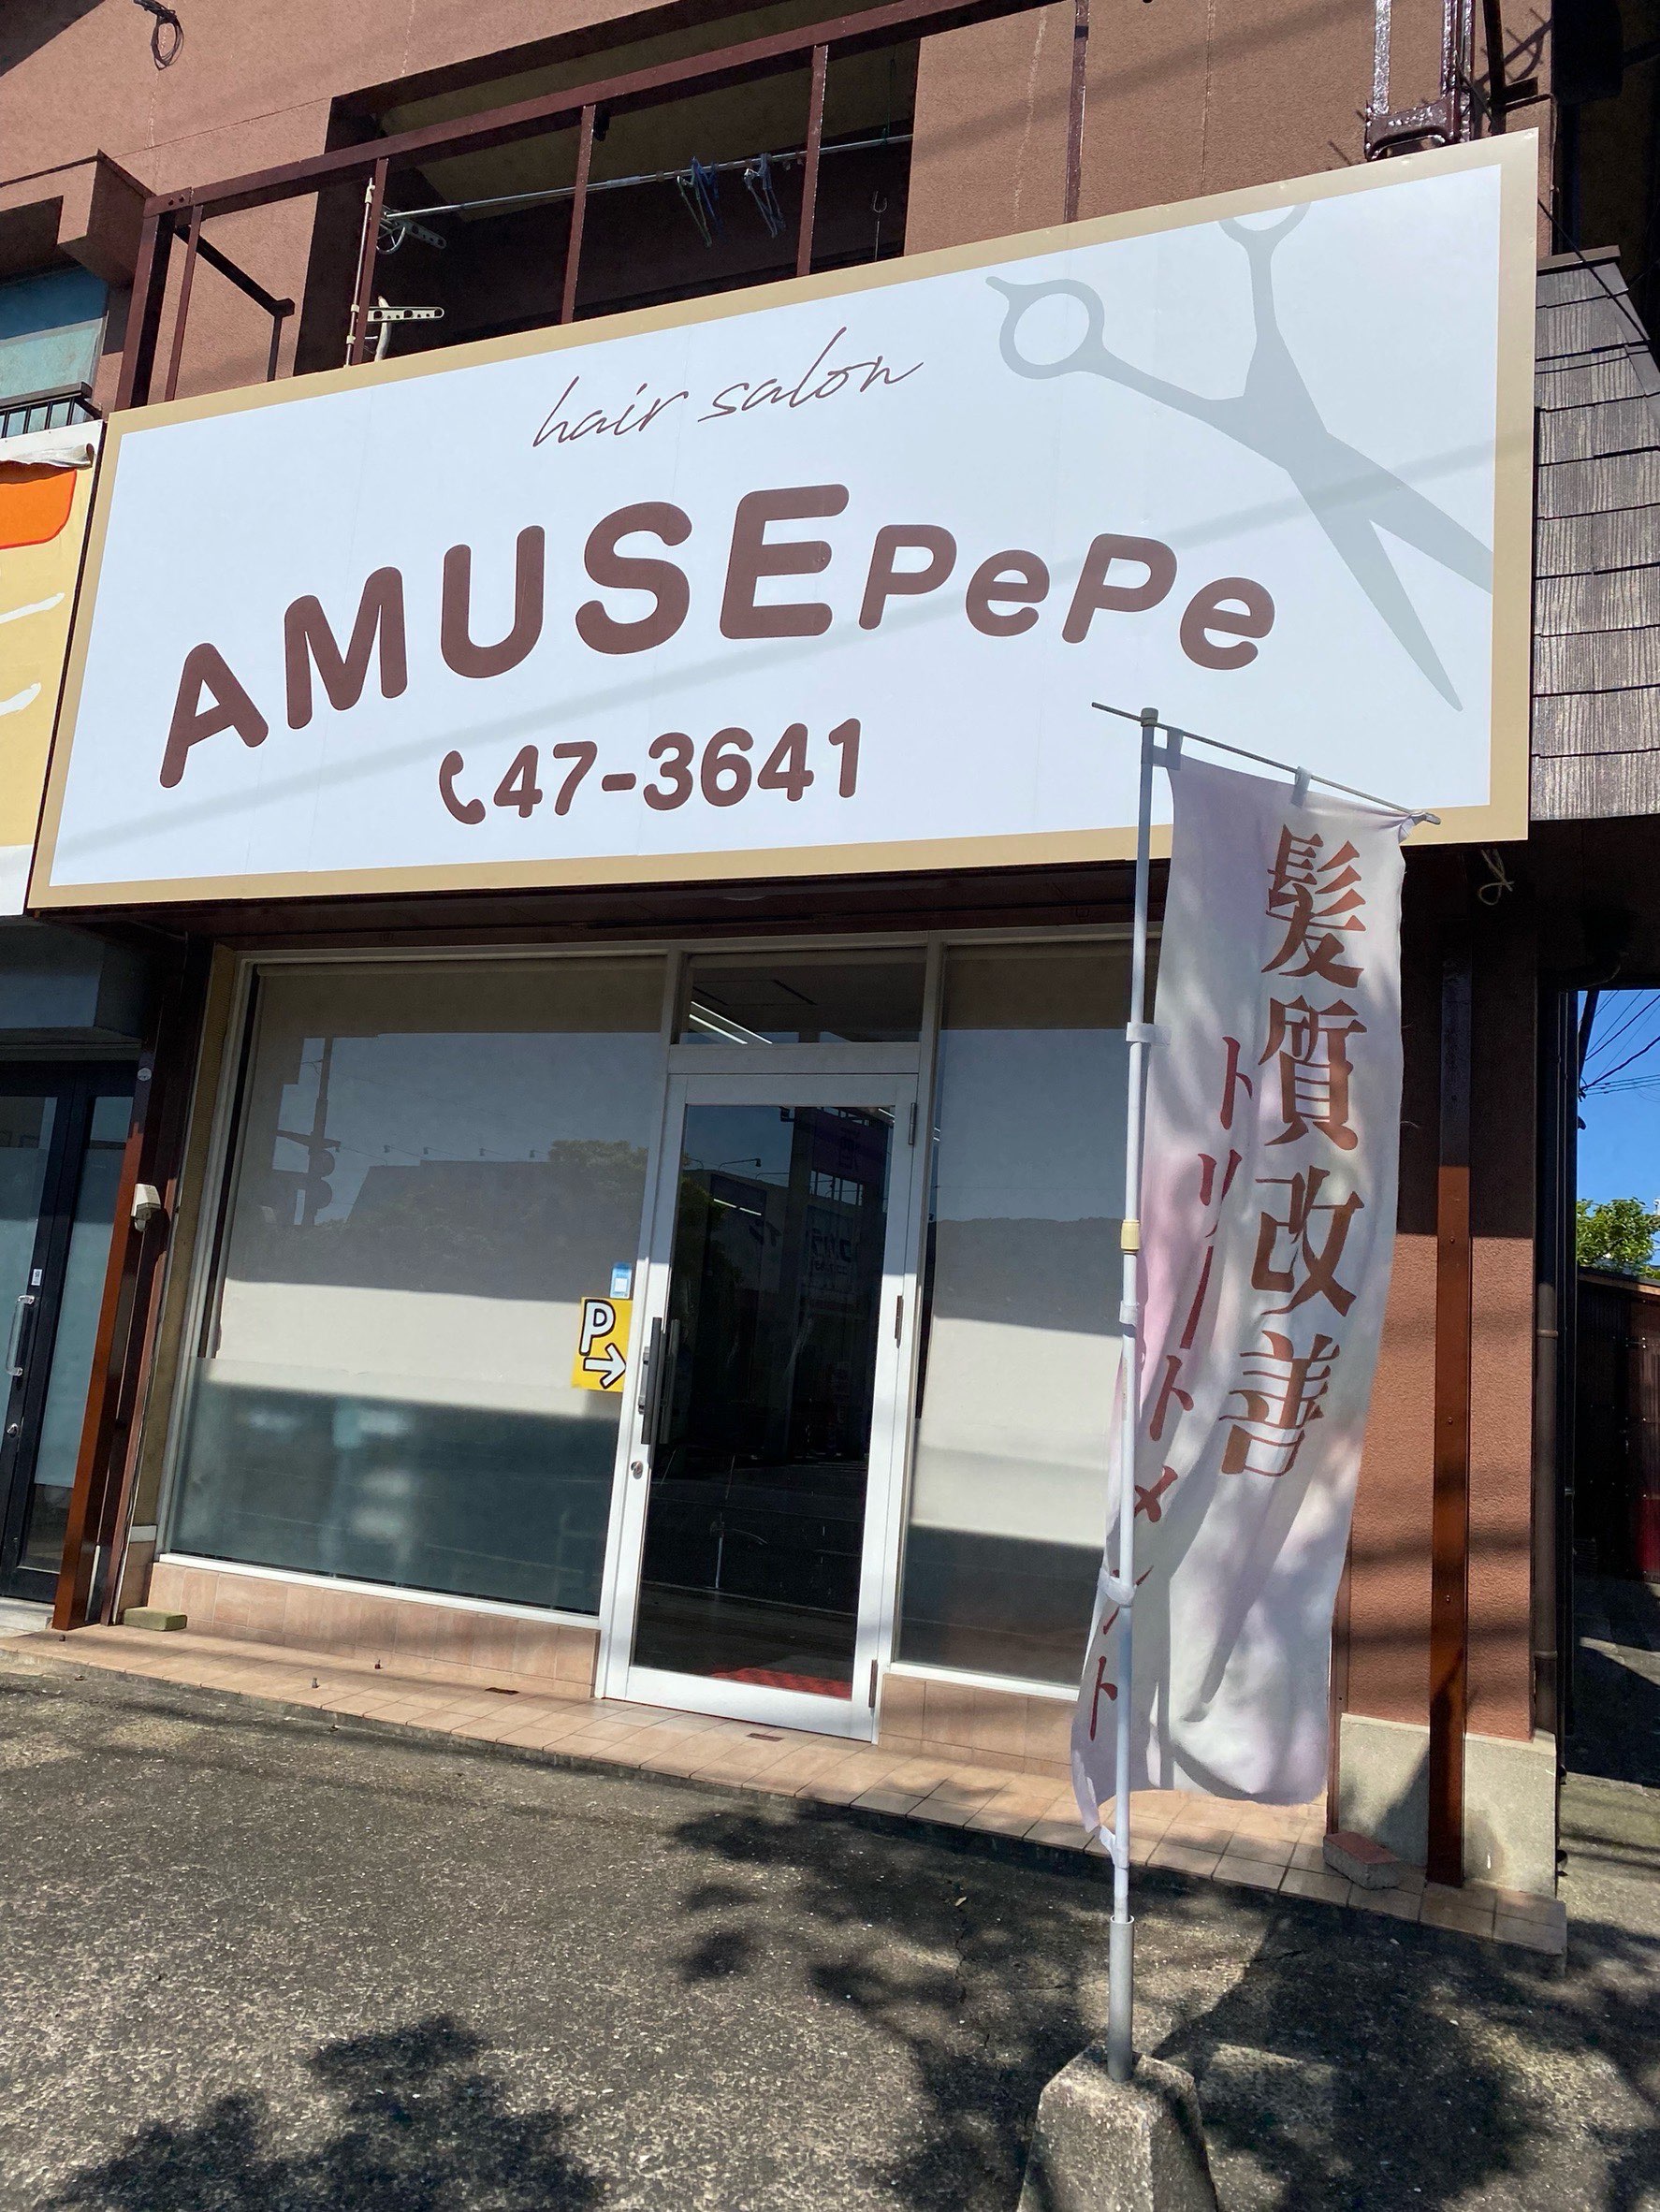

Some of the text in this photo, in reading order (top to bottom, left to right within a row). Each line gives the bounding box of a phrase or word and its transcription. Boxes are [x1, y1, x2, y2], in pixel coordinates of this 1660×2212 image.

[533, 327, 924, 447] hair salon
[494, 719, 860, 818] 47-3641
[1219, 823, 1367, 1477] 髪質改善
[579, 1298, 617, 1356] P
